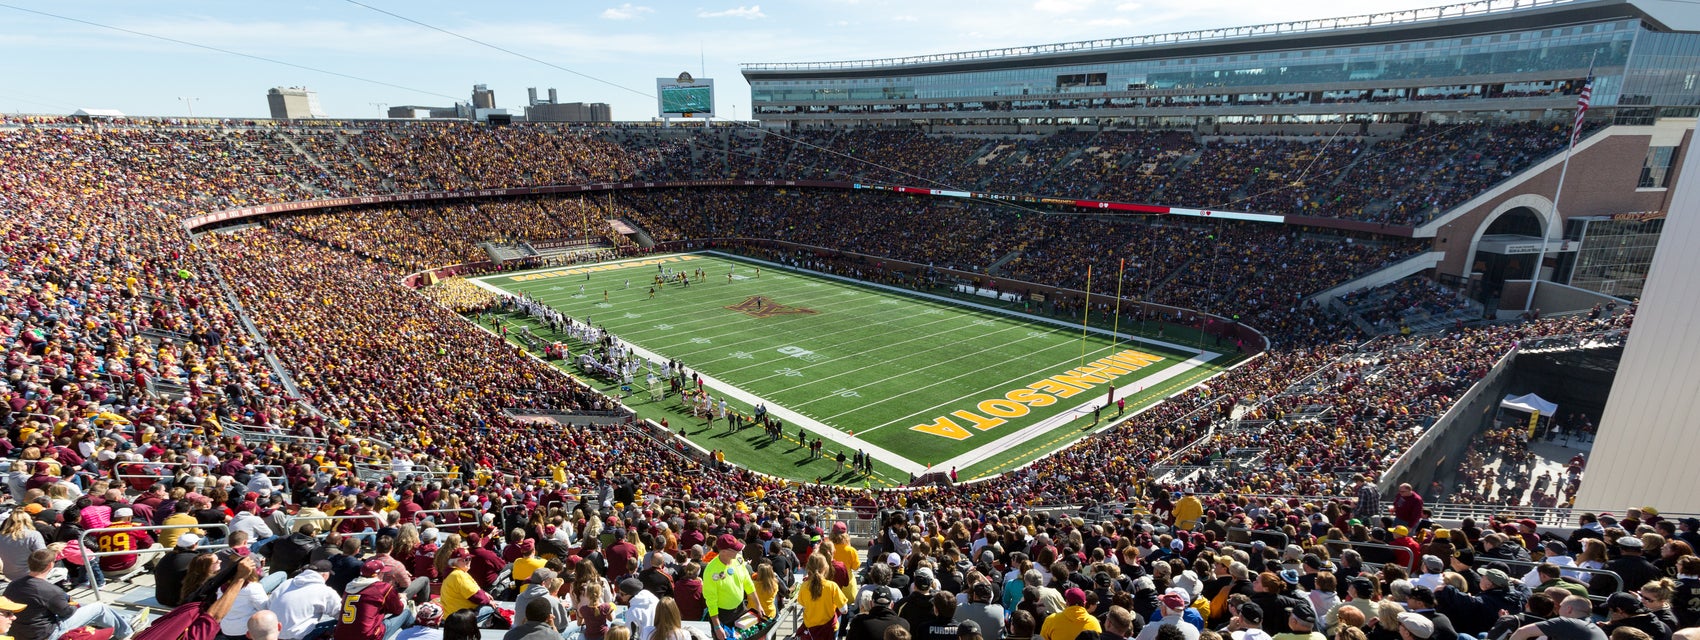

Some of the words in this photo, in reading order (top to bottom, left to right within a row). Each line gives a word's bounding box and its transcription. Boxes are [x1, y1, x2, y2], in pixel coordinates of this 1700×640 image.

[301, 198, 353, 208] CHAMPIONSHIPS
[831, 387, 859, 398] 10
[908, 349, 1166, 441] MINNESOTA
[99, 532, 130, 552] 89
[342, 594, 361, 624] 5
